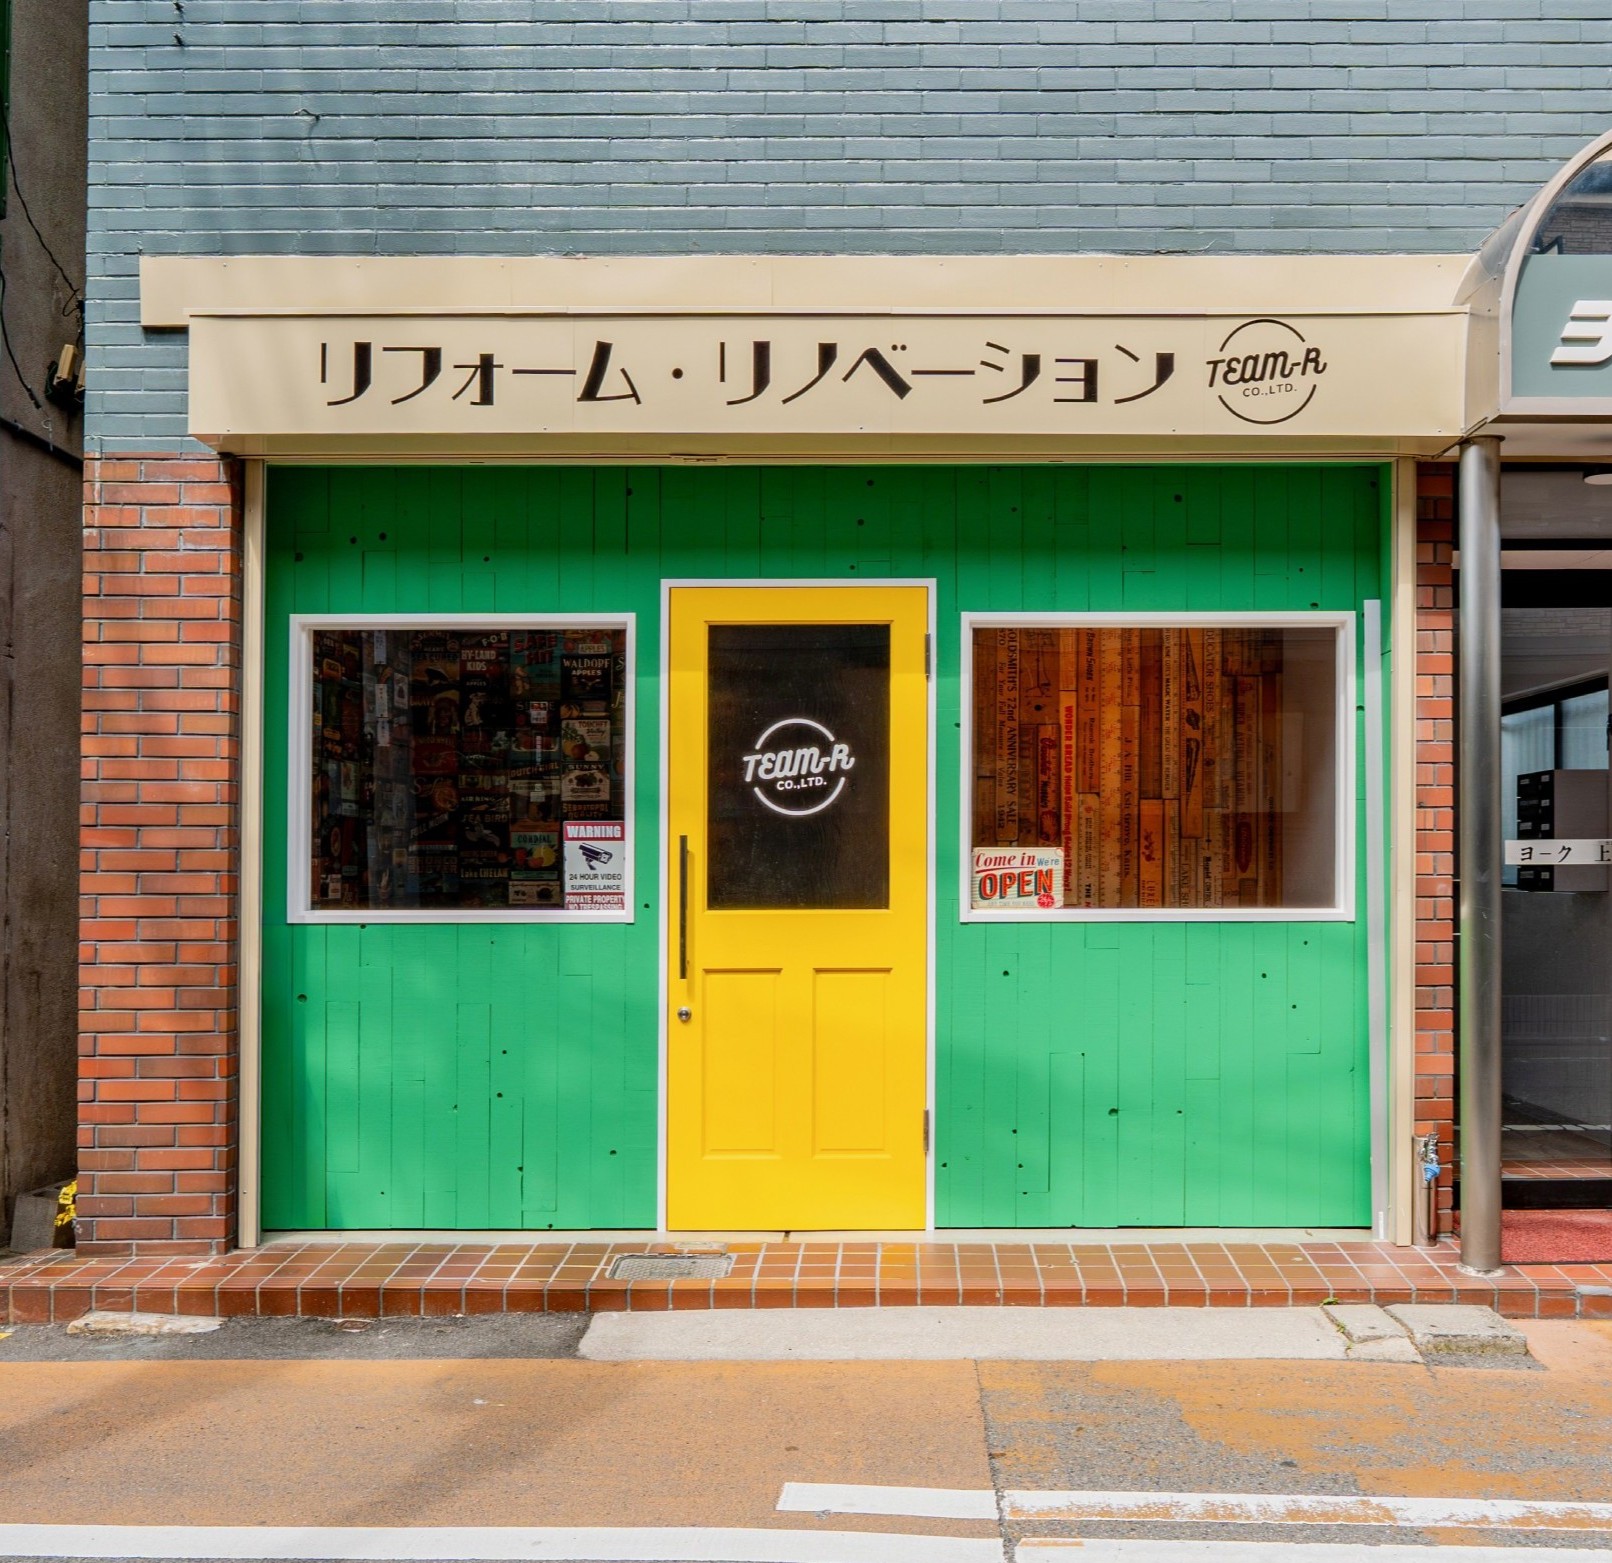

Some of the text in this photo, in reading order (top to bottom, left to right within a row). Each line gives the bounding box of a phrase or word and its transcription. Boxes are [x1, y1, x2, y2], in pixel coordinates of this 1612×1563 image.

[320, 340, 1175, 406] リフォーム・リノベーション
[562, 658, 611, 669] WALDORF
[1064, 705, 1073, 741] WONDER
[1007, 726, 1017, 795] ANNIVERSARY
[776, 776, 828, 790] CO.,LTD.
[1007, 801, 1017, 825] SALE
[566, 825, 622, 838] WARNING
[975, 852, 1016, 868] Come
[1020, 853, 1036, 866] in
[569, 873, 622, 881] 24 HOUR VIDEO
[979, 868, 1053, 900] OPEN
[565, 894, 624, 904] PRIVATE PROPERTY
